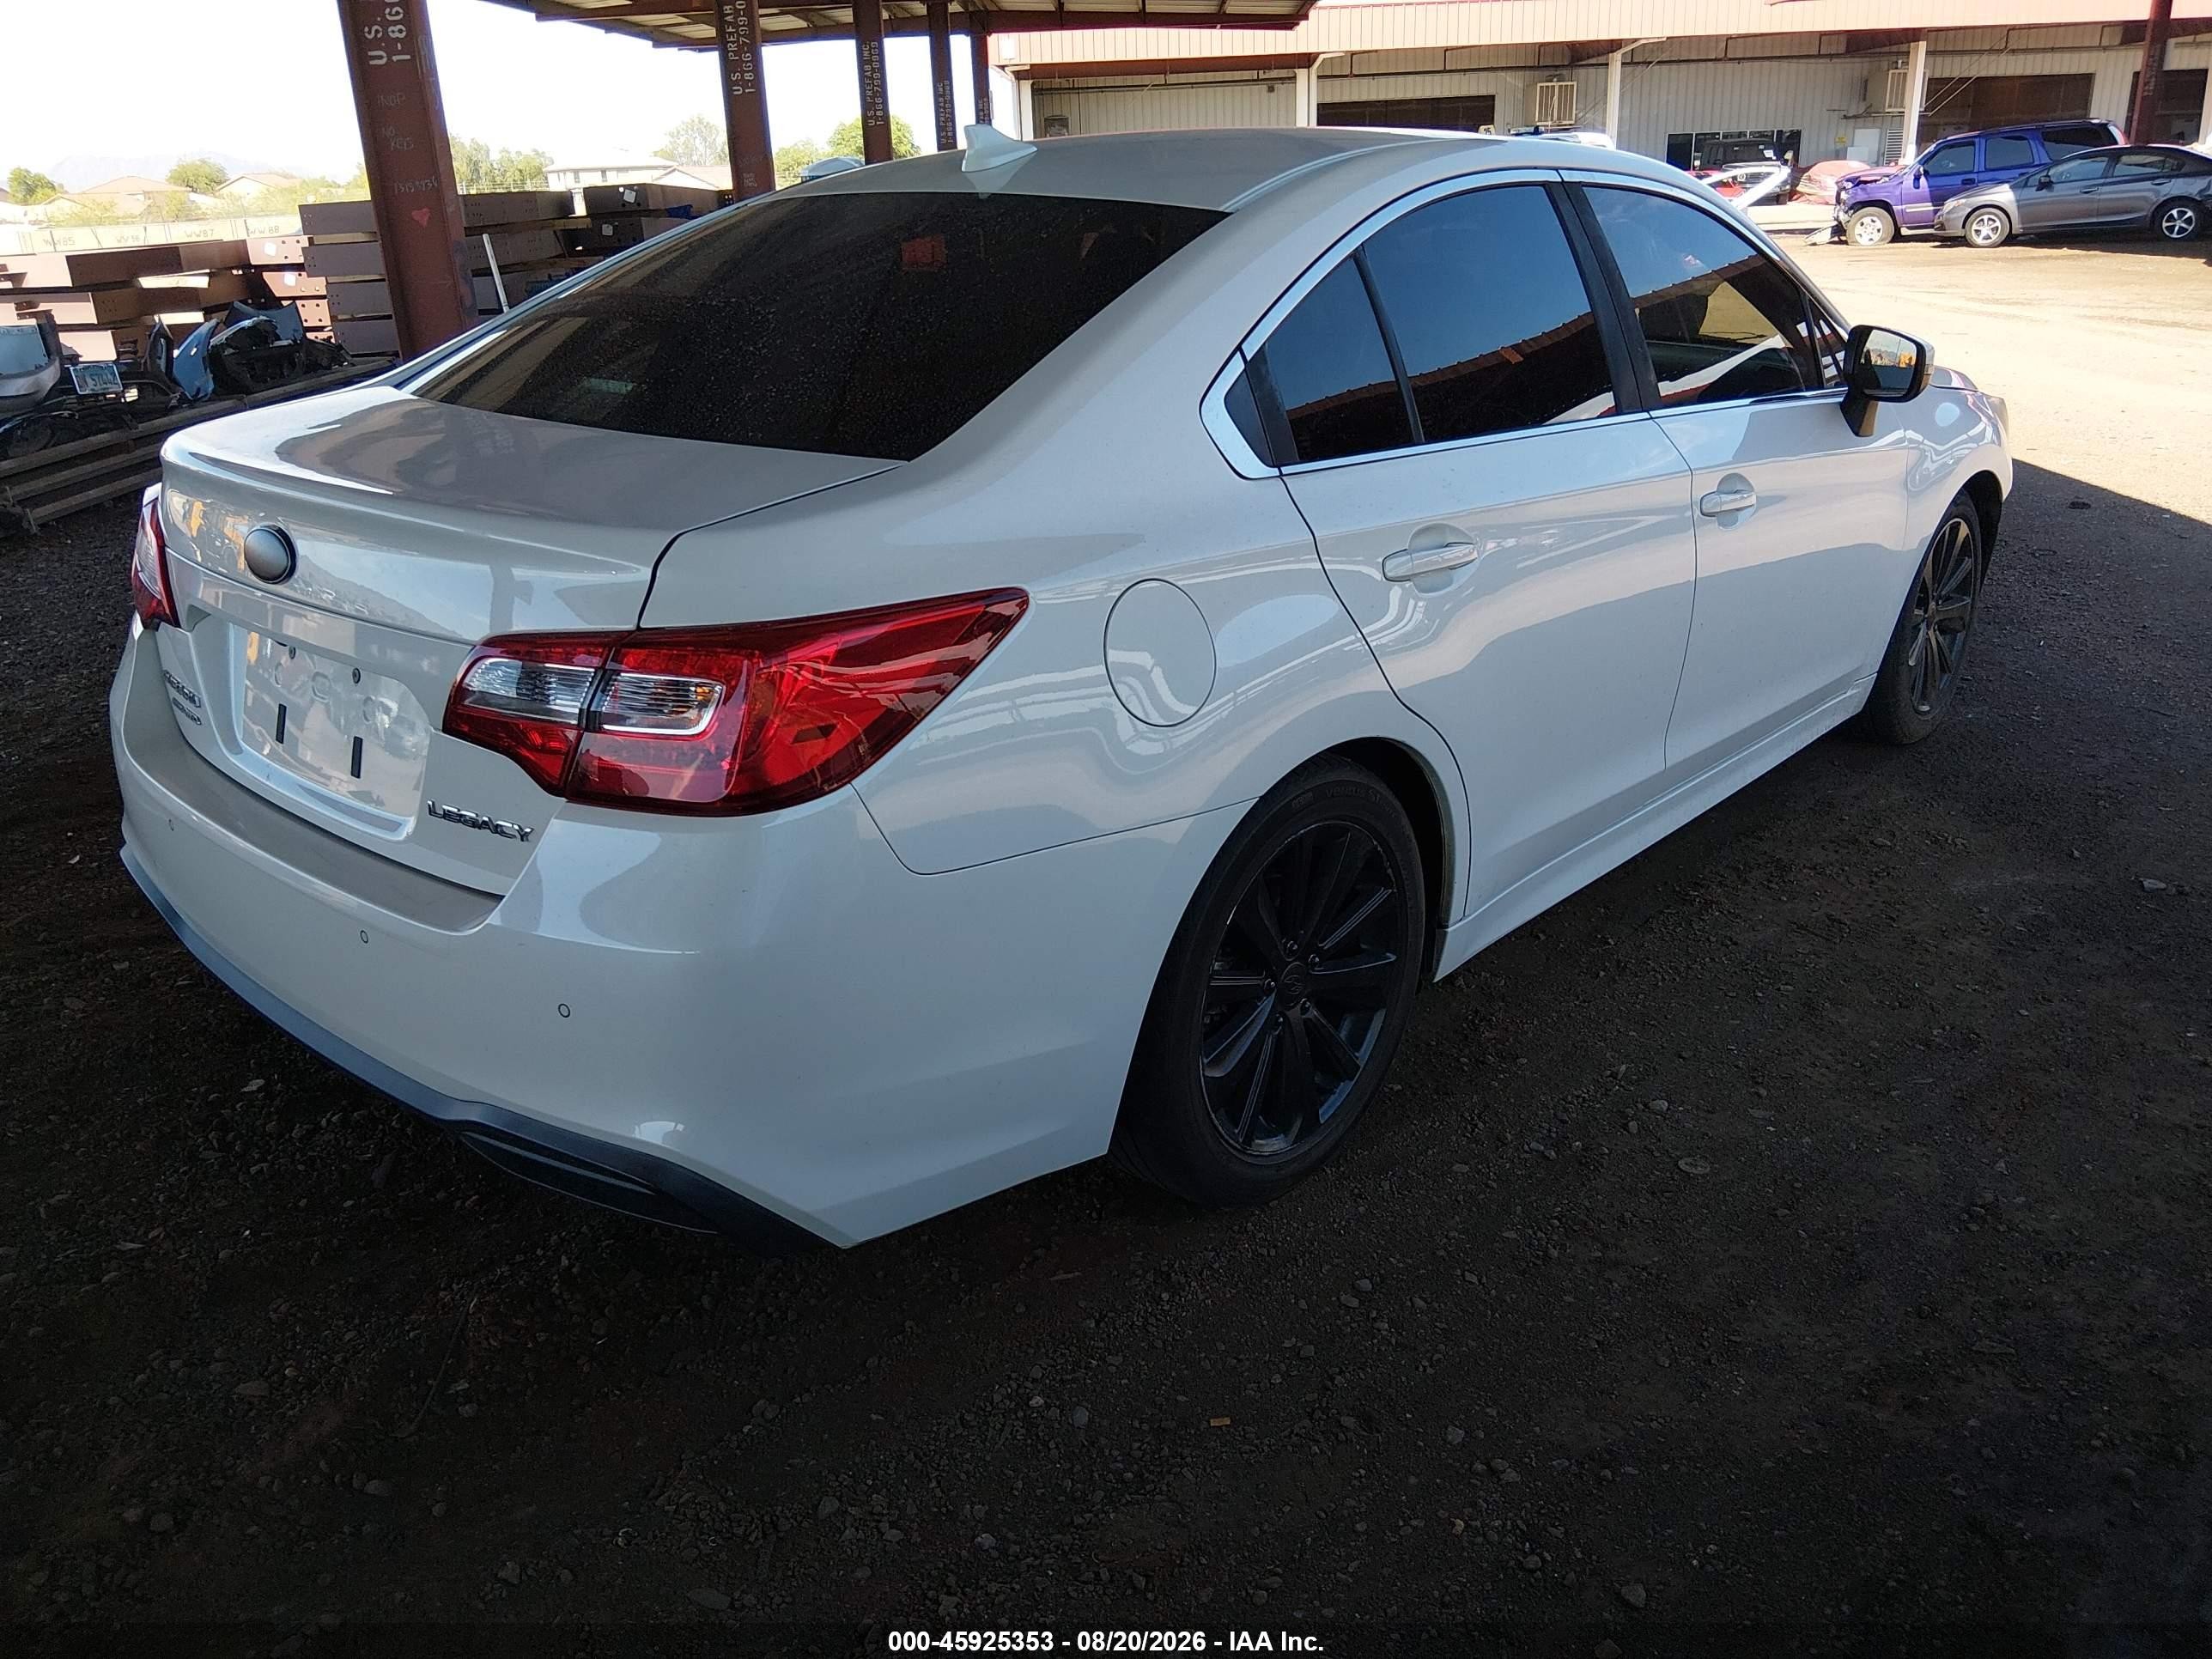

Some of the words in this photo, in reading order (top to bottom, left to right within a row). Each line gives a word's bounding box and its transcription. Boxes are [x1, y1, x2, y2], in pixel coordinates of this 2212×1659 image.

[385, 0, 411, 62] 1-86
[723, 5, 740, 61] PREFAB
[864, 64, 874, 102] PREFAB
[428, 799, 534, 842] LEGACY
